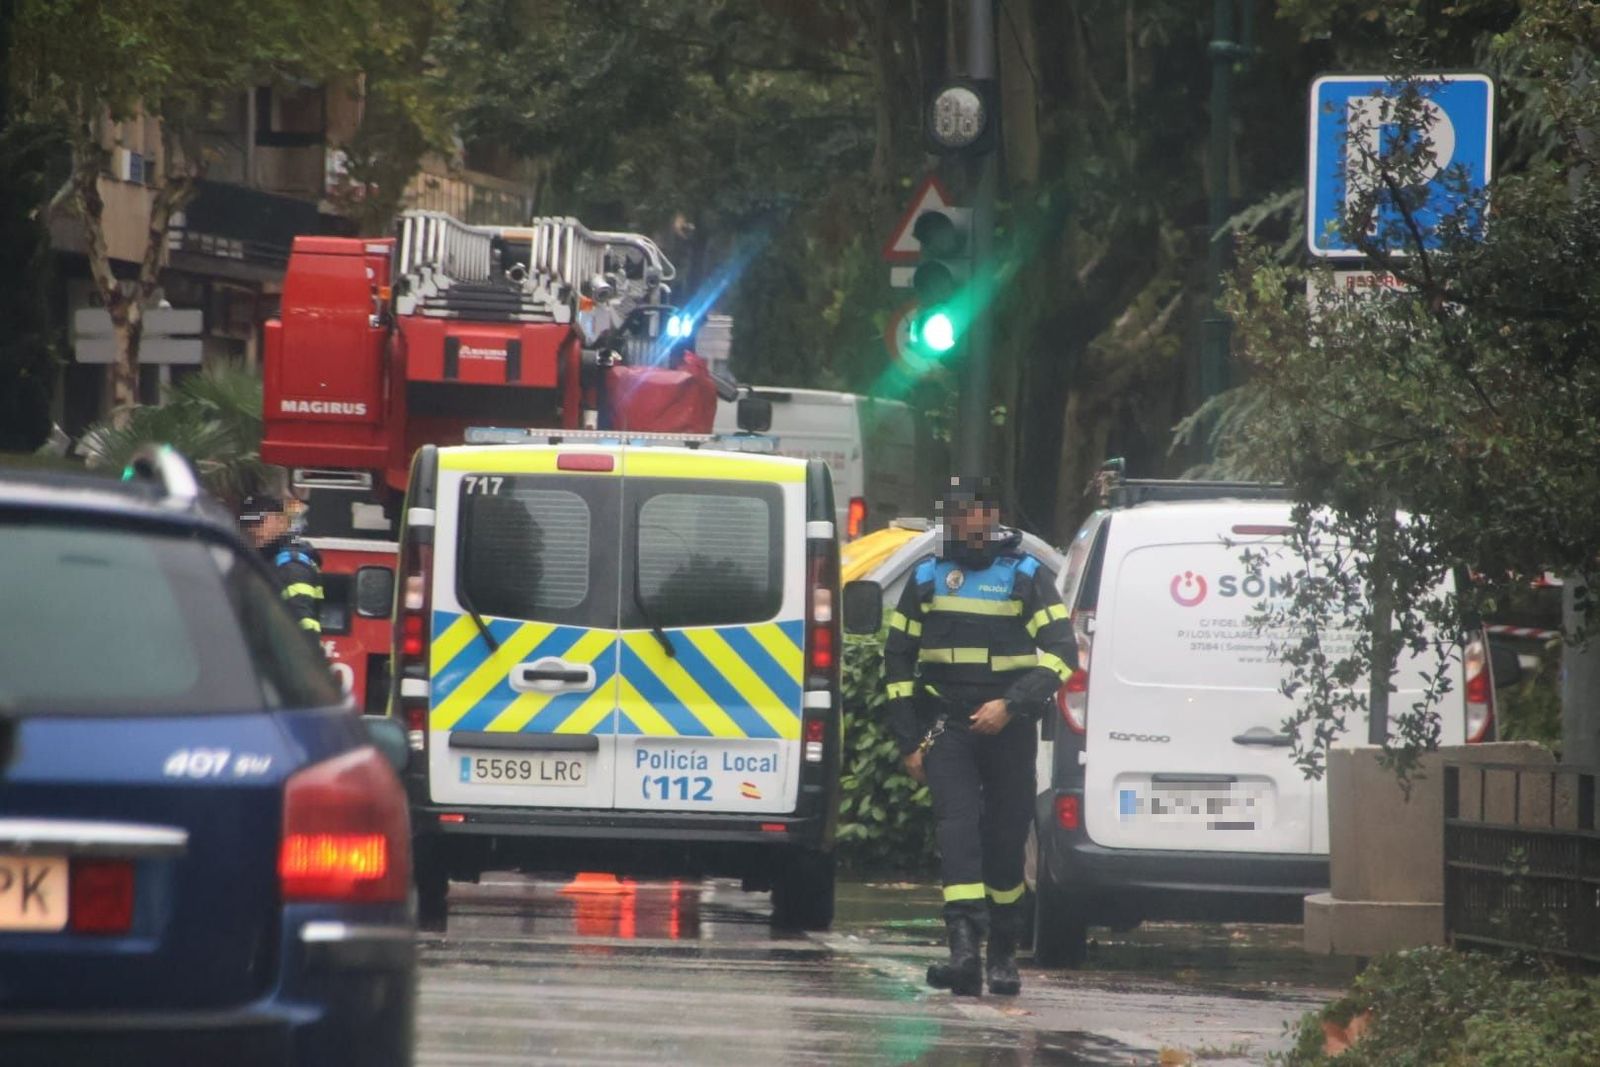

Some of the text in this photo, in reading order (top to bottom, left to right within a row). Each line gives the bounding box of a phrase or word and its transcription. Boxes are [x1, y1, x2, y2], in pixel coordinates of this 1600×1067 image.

[1346, 96, 1456, 236] P
[281, 400, 367, 416] MAGIRUS
[464, 476, 504, 495] 717
[163, 749, 230, 778] 407
[476, 758, 582, 781] 5569 LRC
[636, 749, 777, 773] Policía Local
[653, 775, 713, 801] 112
